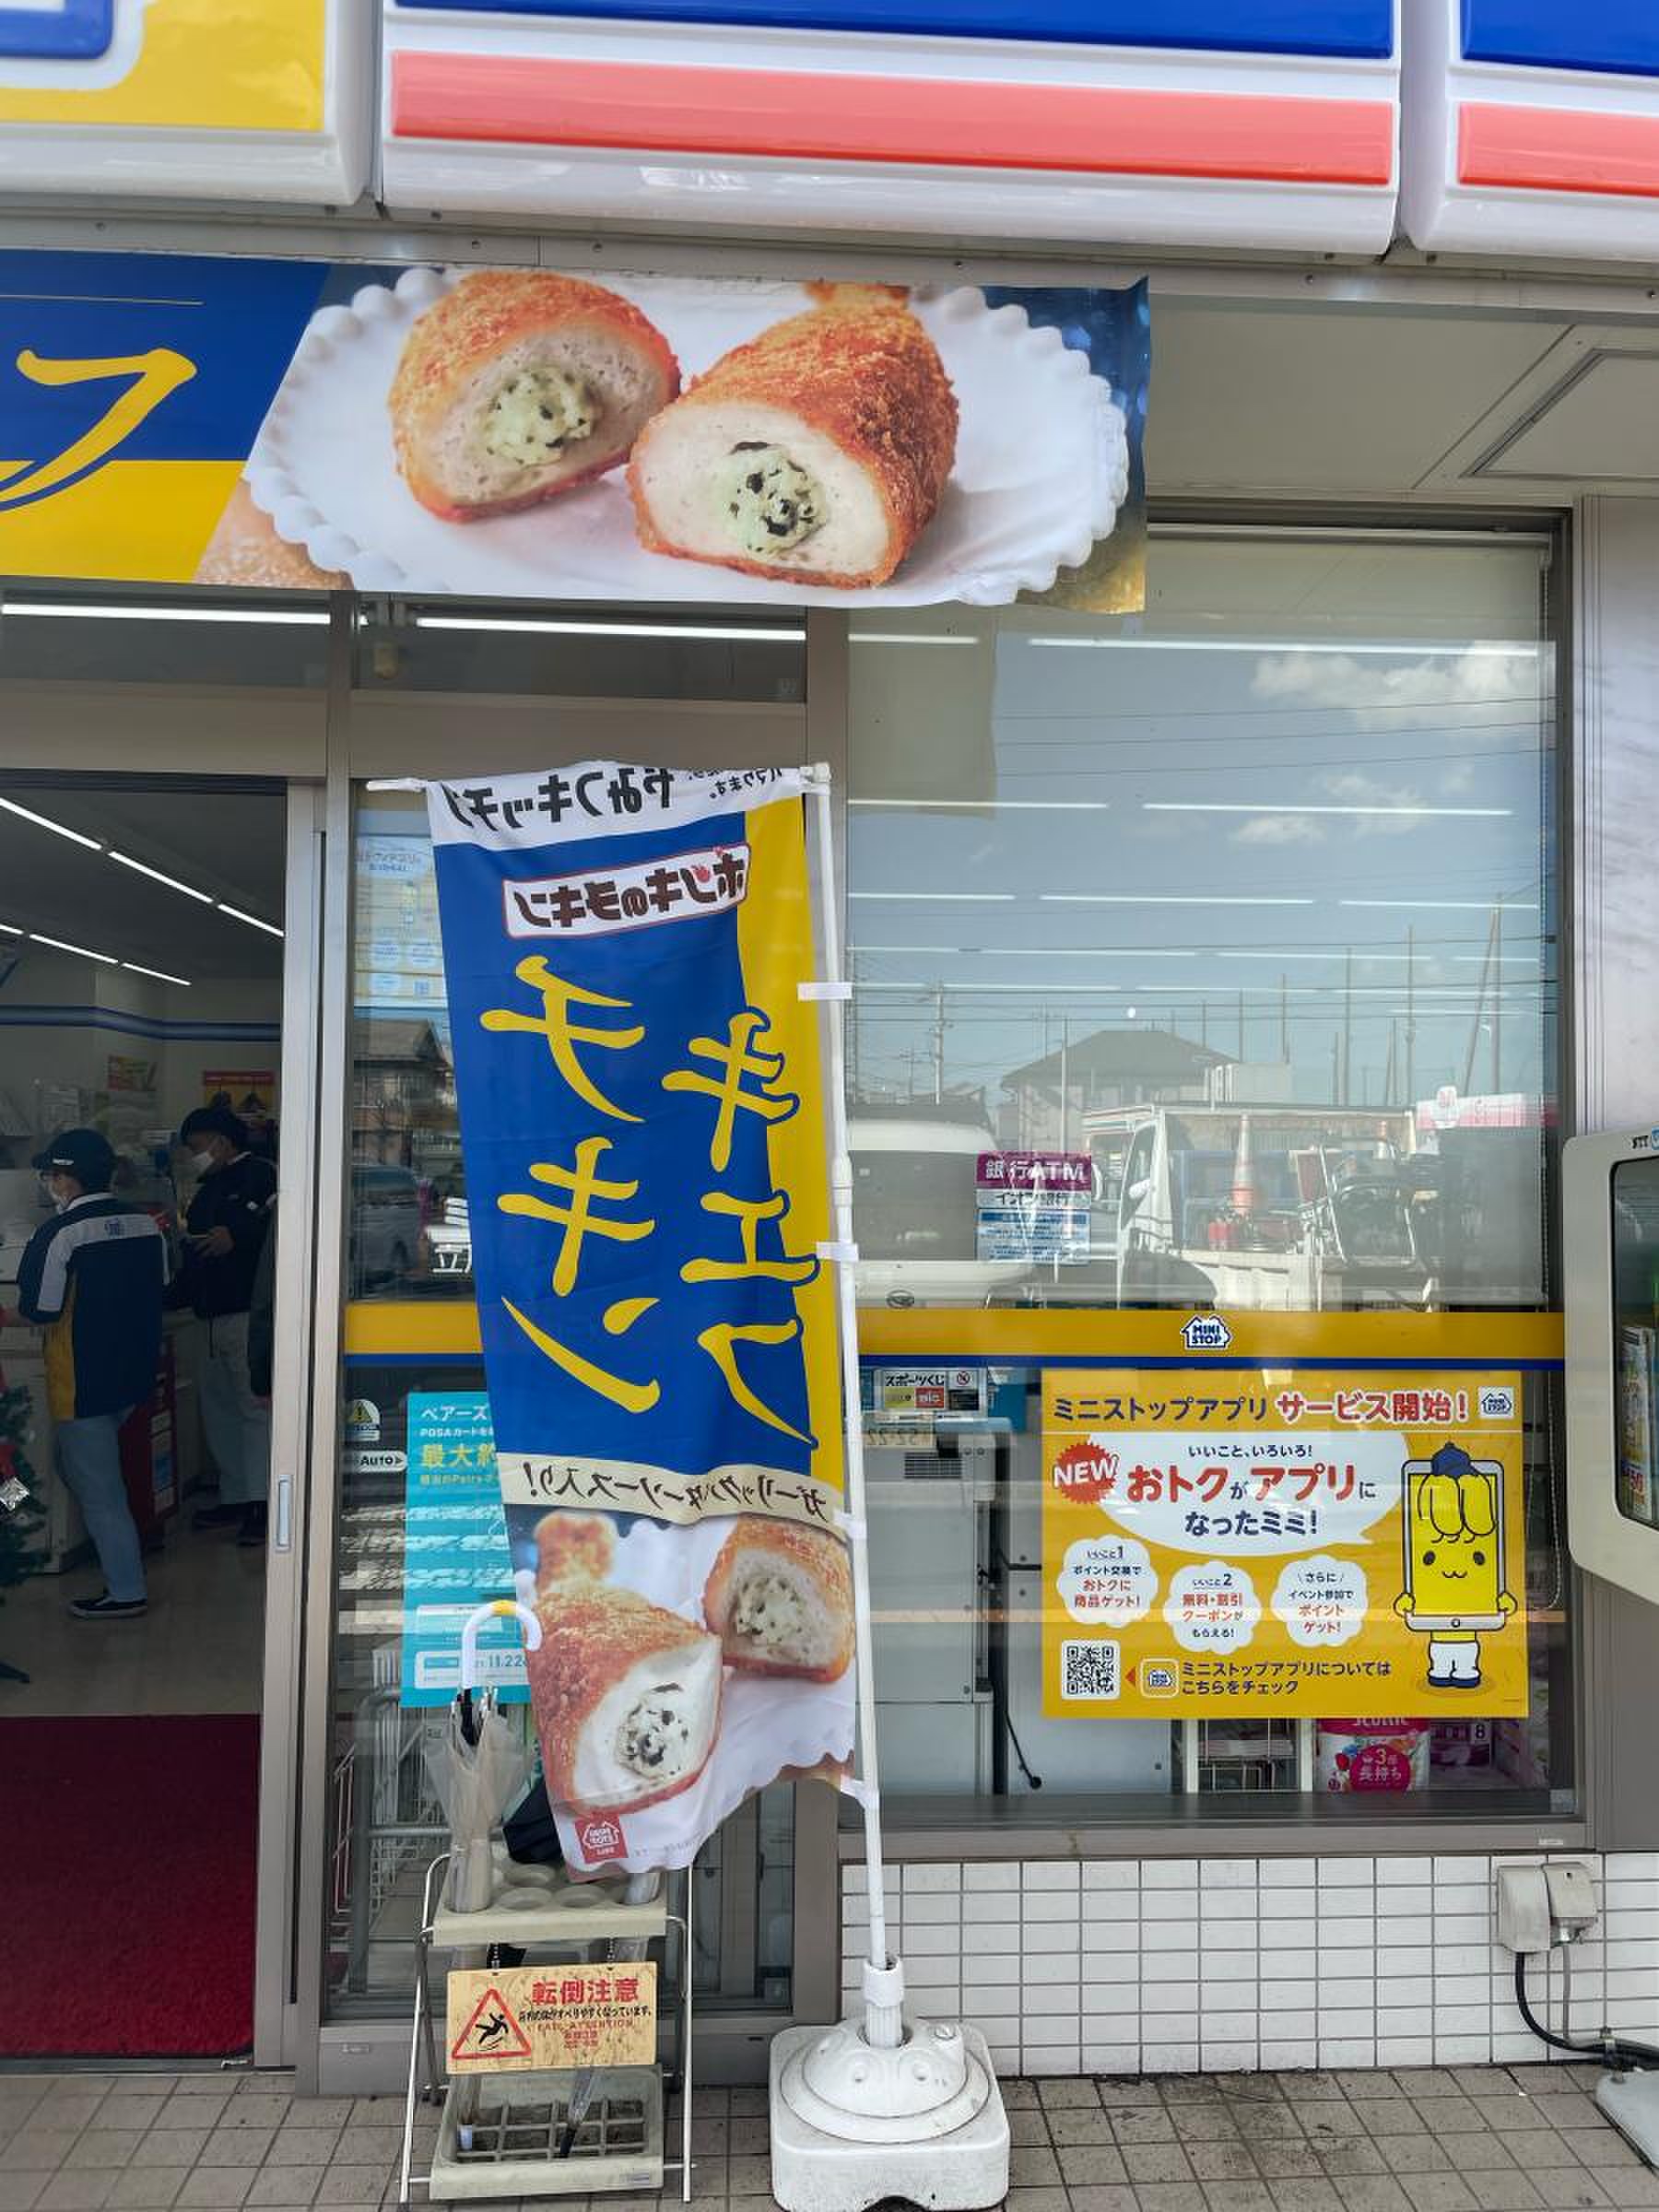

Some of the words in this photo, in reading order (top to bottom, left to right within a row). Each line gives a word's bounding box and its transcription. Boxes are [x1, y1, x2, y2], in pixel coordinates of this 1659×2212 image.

[1193, 1324, 1220, 1335] MINI
[1192, 1334, 1223, 1344] STOP
[1053, 1395, 1267, 1422] ミニストップアプリ
[1277, 1391, 1468, 1422] サービス開始!
[1188, 1444, 1312, 1458] いいこと、いろいろ!
[1053, 1456, 1117, 1488] NEW
[1185, 1509, 1318, 1535] なったミミ!
[1304, 1571, 1337, 1583] さらに
[1083, 1578, 1132, 1592] おトクに
[1075, 1594, 1141, 1609] 商品ゲット!
[1299, 1604, 1344, 1618] ポイント
[1192, 1628, 1235, 1639] もらえる!
[1302, 1620, 1342, 1634] ゲット!
[1182, 1661, 1392, 1677] ミニストップアプリについては
[1182, 1680, 1299, 1696] こちらをチェック
[532, 1977, 639, 2006] 転倒注意
